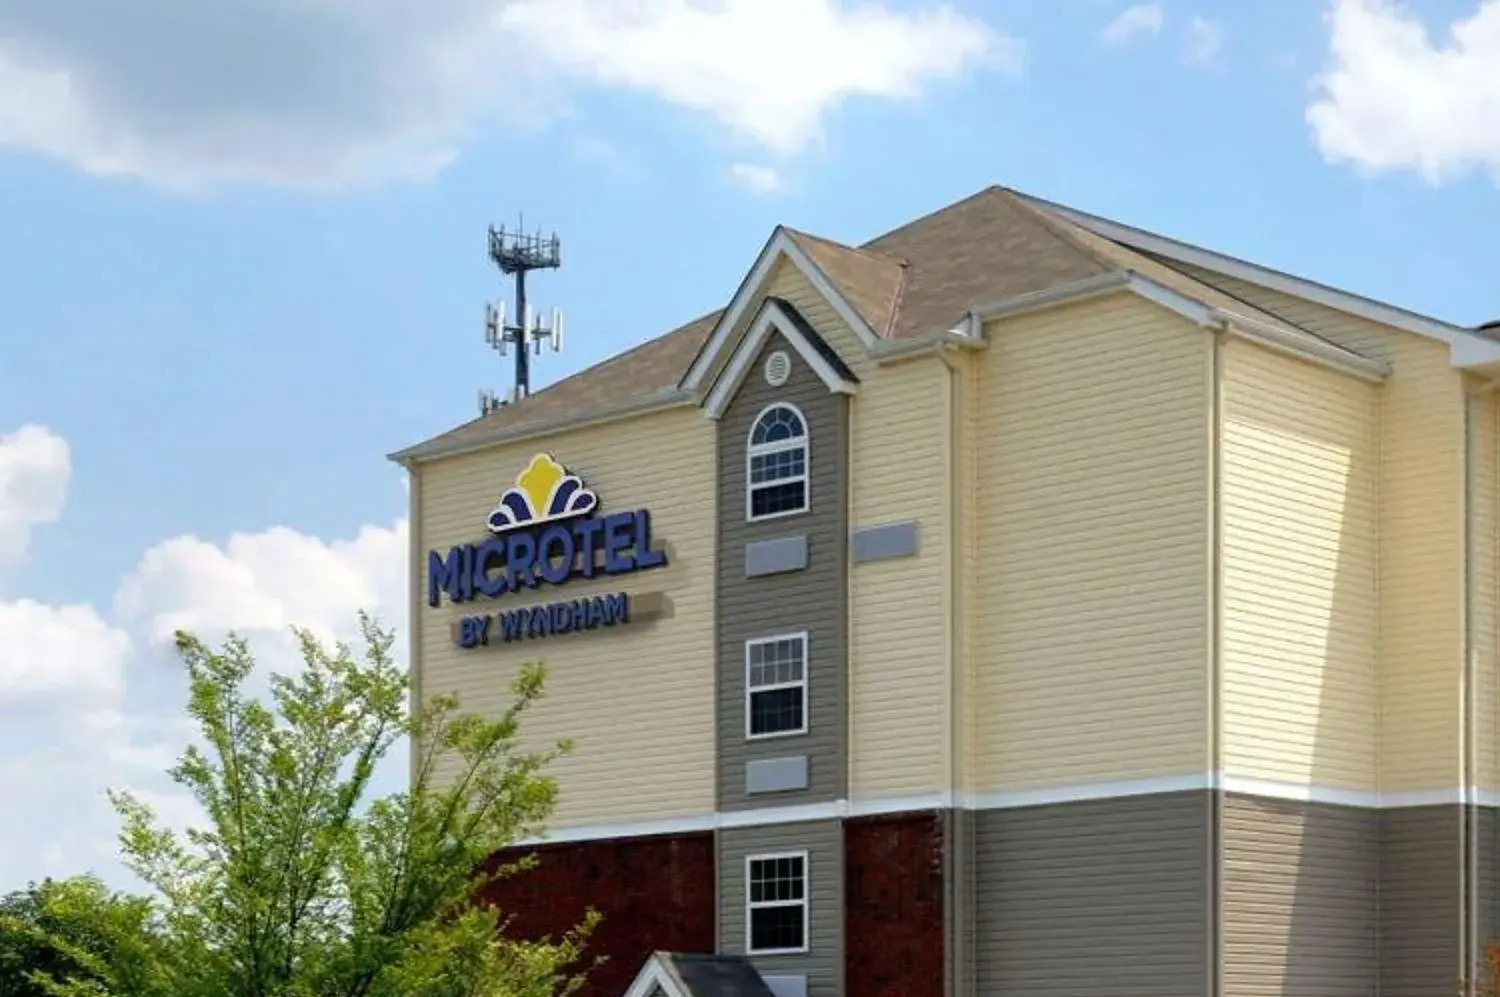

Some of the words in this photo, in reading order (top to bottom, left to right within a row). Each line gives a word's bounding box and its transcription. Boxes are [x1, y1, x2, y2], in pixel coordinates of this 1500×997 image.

[428, 509, 668, 608] MICROTEL
[458, 614, 491, 648] BY
[501, 591, 630, 642] WYNDHAM
